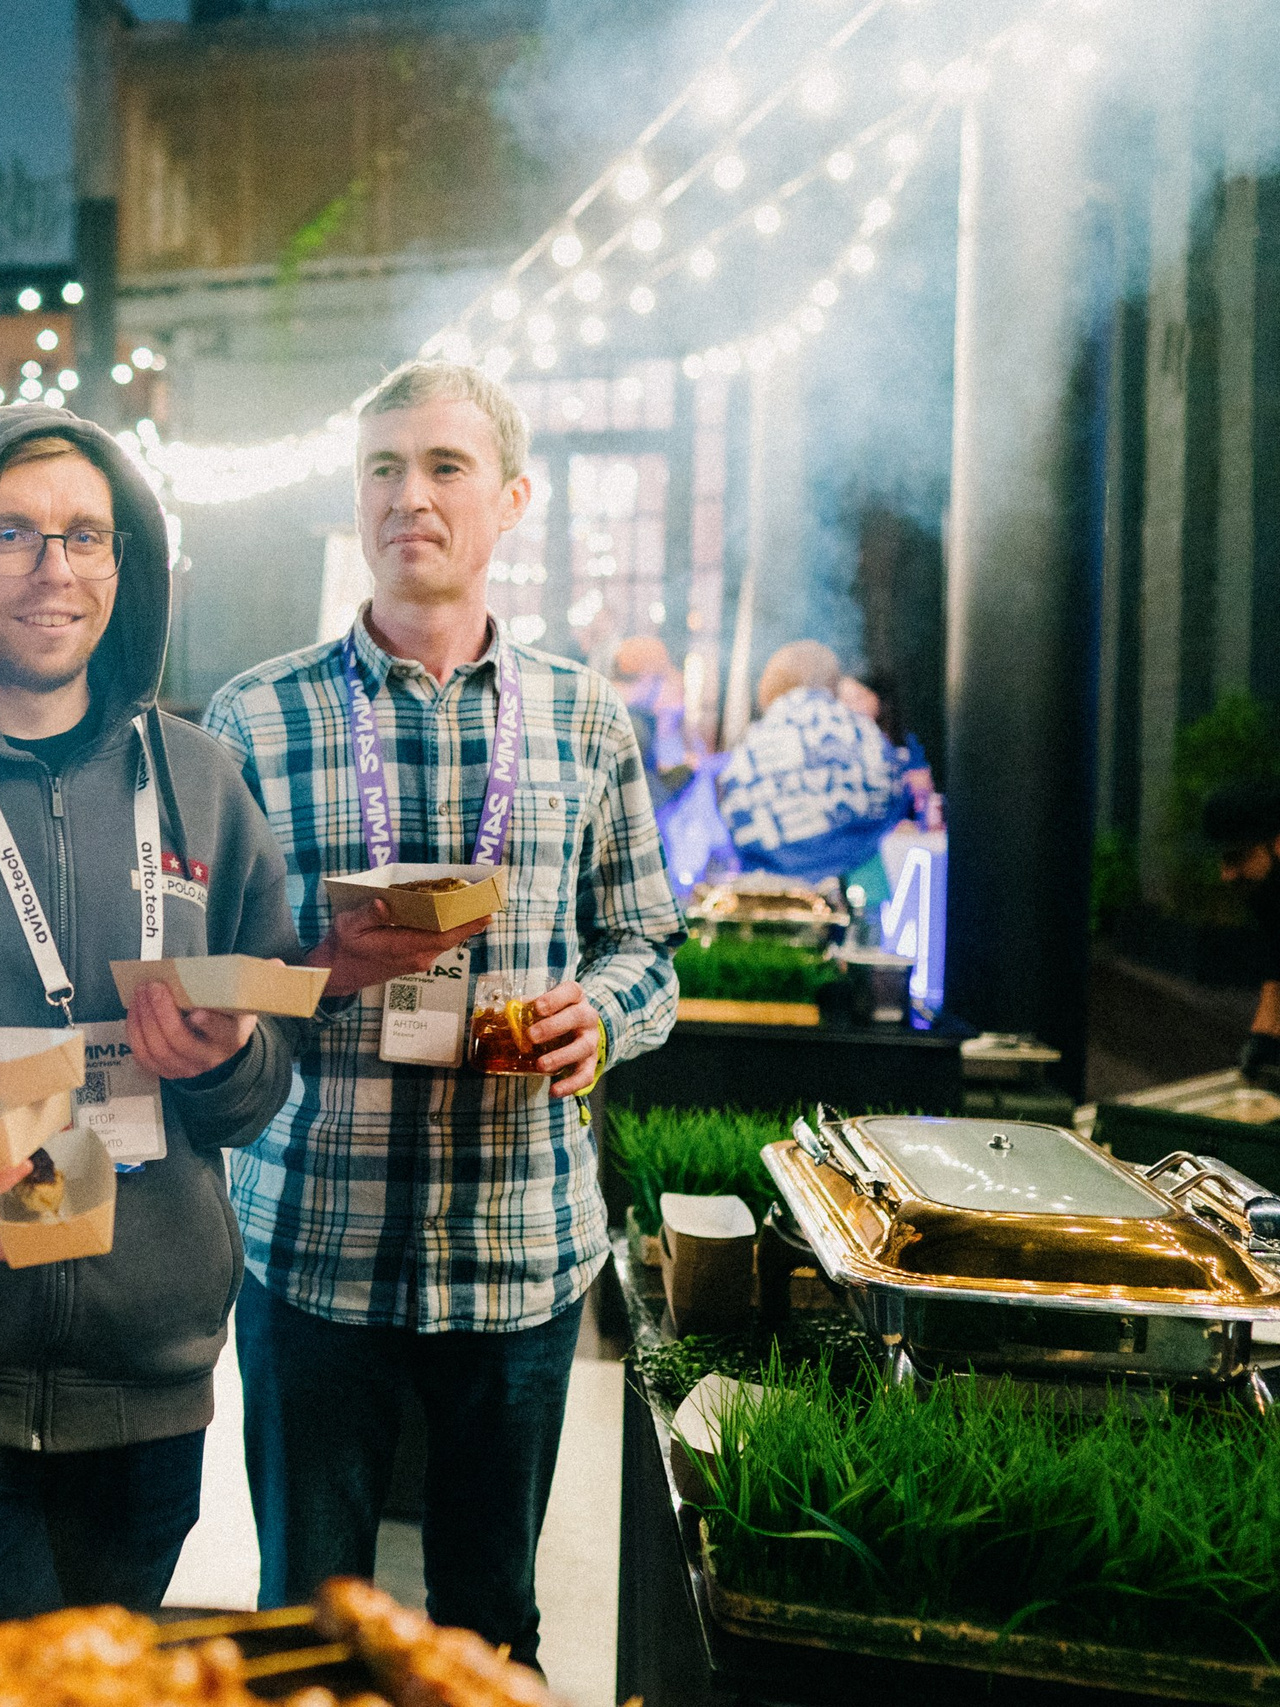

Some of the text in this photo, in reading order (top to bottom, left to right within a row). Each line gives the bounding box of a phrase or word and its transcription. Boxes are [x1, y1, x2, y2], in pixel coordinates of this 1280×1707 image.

[363, 785, 392, 868] MMA
[0, 847, 48, 944] avito.tech
[140, 841, 159, 938] avito.tech
[167, 880, 196, 898] POLO
[393, 1019, 428, 1031] АНТОН
[88, 1113, 116, 1126] ЕГОР
